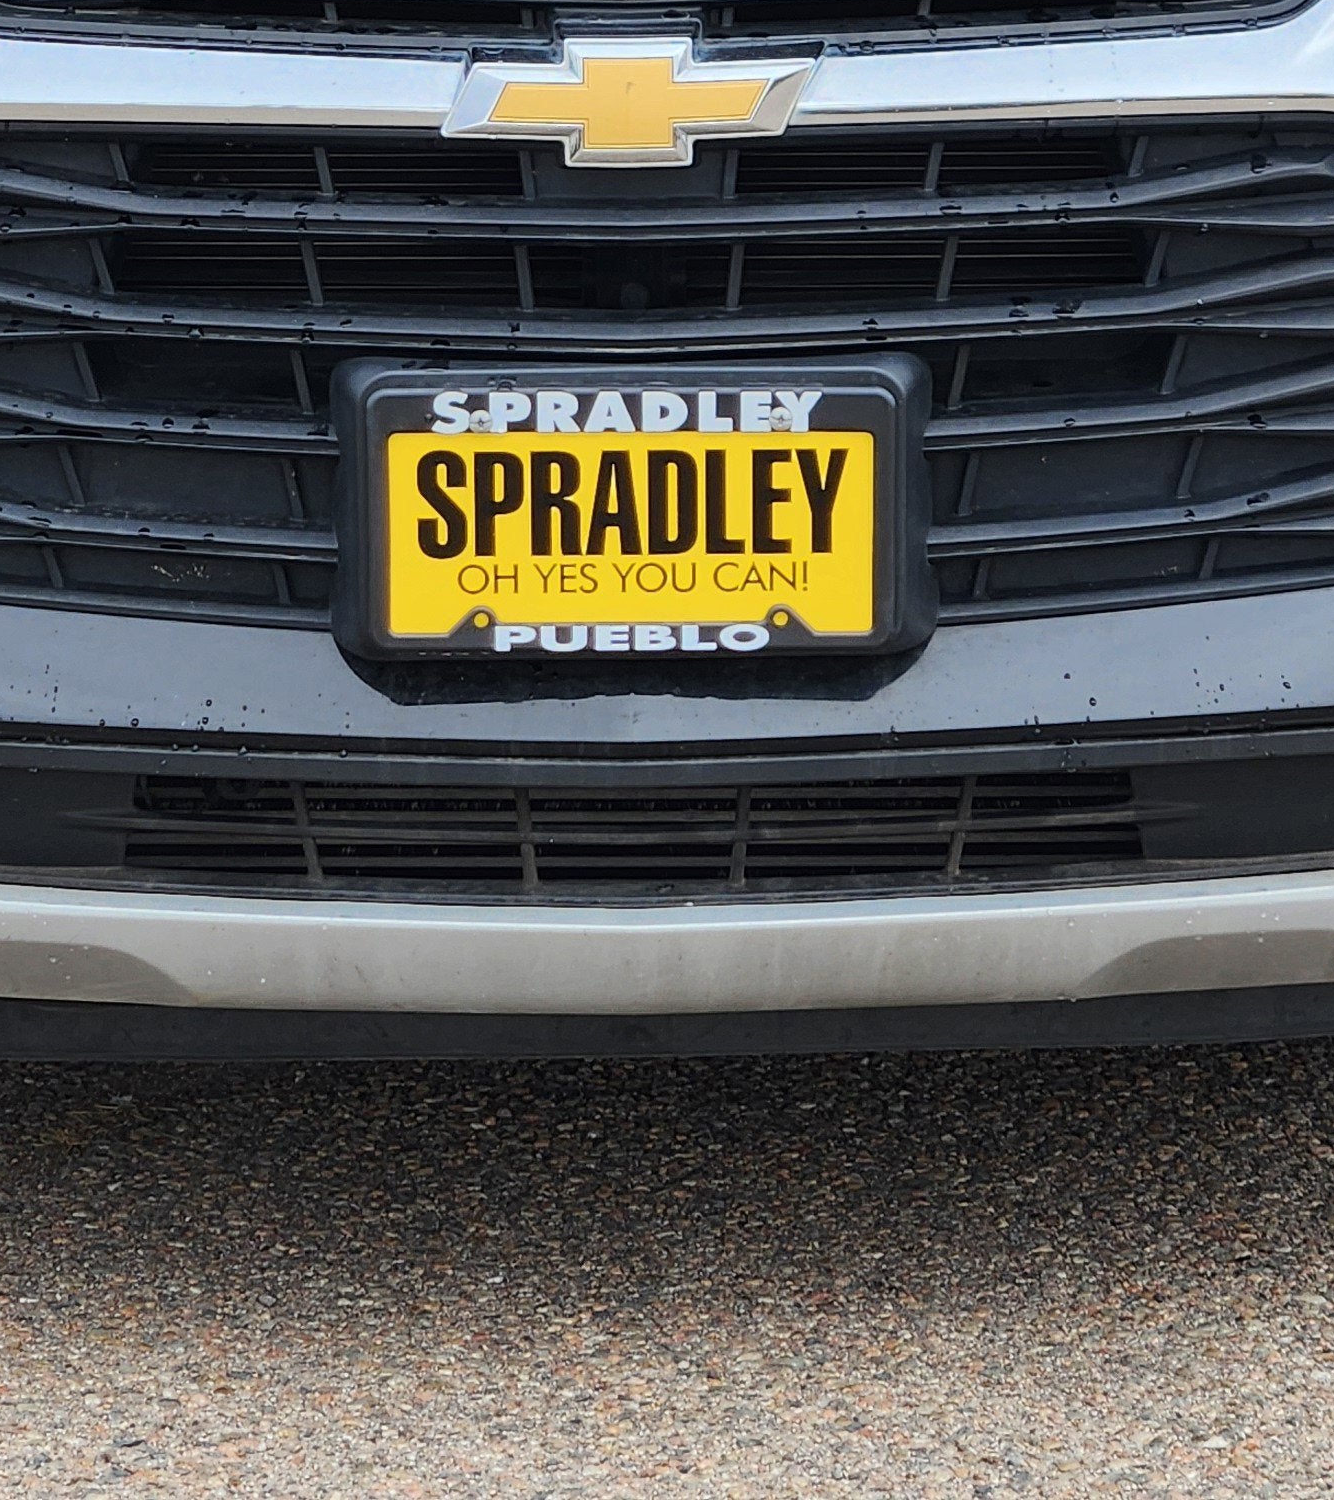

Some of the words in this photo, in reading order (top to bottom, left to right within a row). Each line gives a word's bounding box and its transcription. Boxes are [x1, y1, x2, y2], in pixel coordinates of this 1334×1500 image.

[431, 390, 824, 434] SPRADLEY
[416, 448, 850, 560] SPRADLEY
[457, 564, 519, 596] OH
[533, 563, 599, 594] YES
[612, 562, 697, 594] YOU
[712, 561, 809, 593] CAN!
[493, 623, 771, 652] PUEBLO
